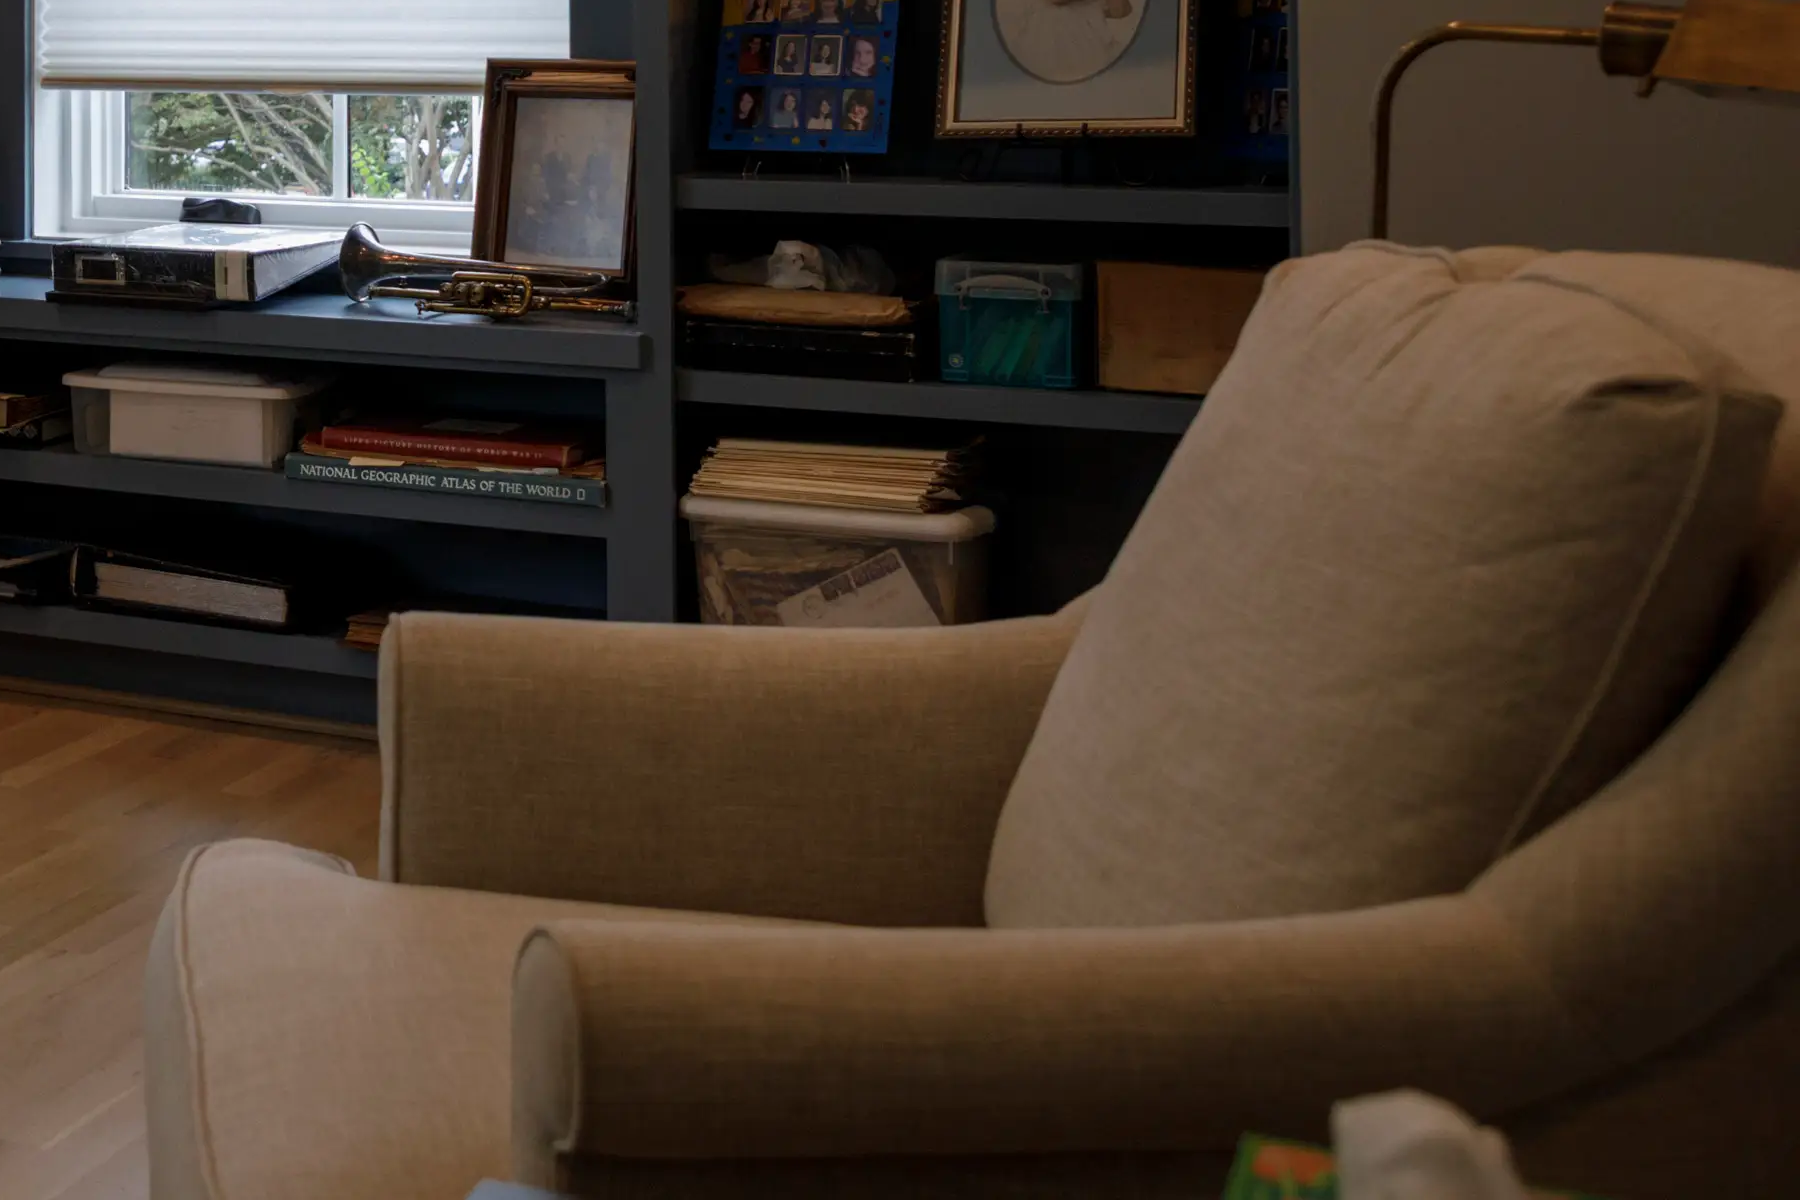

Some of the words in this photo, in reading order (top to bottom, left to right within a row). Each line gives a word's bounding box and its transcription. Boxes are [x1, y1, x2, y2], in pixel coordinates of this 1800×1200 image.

[299, 463, 358, 481] NATIONAL
[360, 469, 437, 488] GEOGRAPHIC
[440, 476, 477, 491] ATLAS
[479, 479, 496, 493] OF
[498, 481, 523, 495] THE
[526, 483, 572, 500] WORLD
